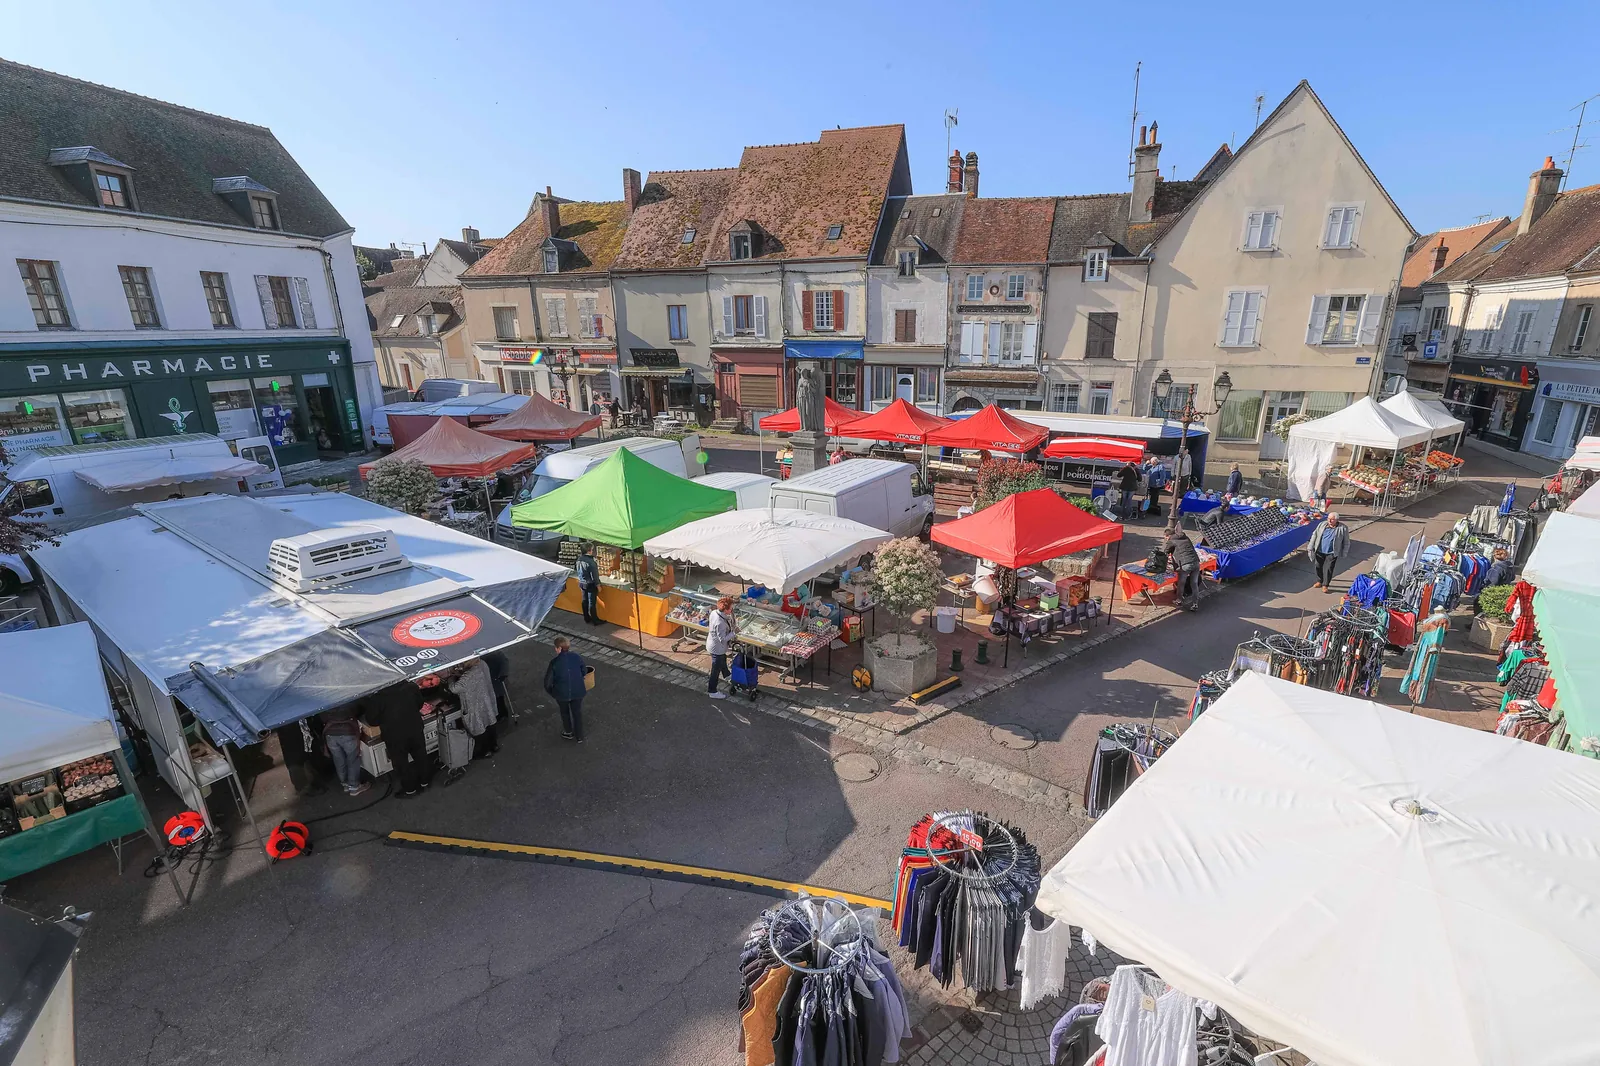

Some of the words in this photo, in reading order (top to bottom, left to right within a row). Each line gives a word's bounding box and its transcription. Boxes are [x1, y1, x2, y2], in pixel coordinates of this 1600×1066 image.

[26, 354, 273, 383] PHARMACIE
[1566, 384, 1591, 394] PETITE
[419, 648, 437, 659] 90
[400, 656, 415, 667] 80
